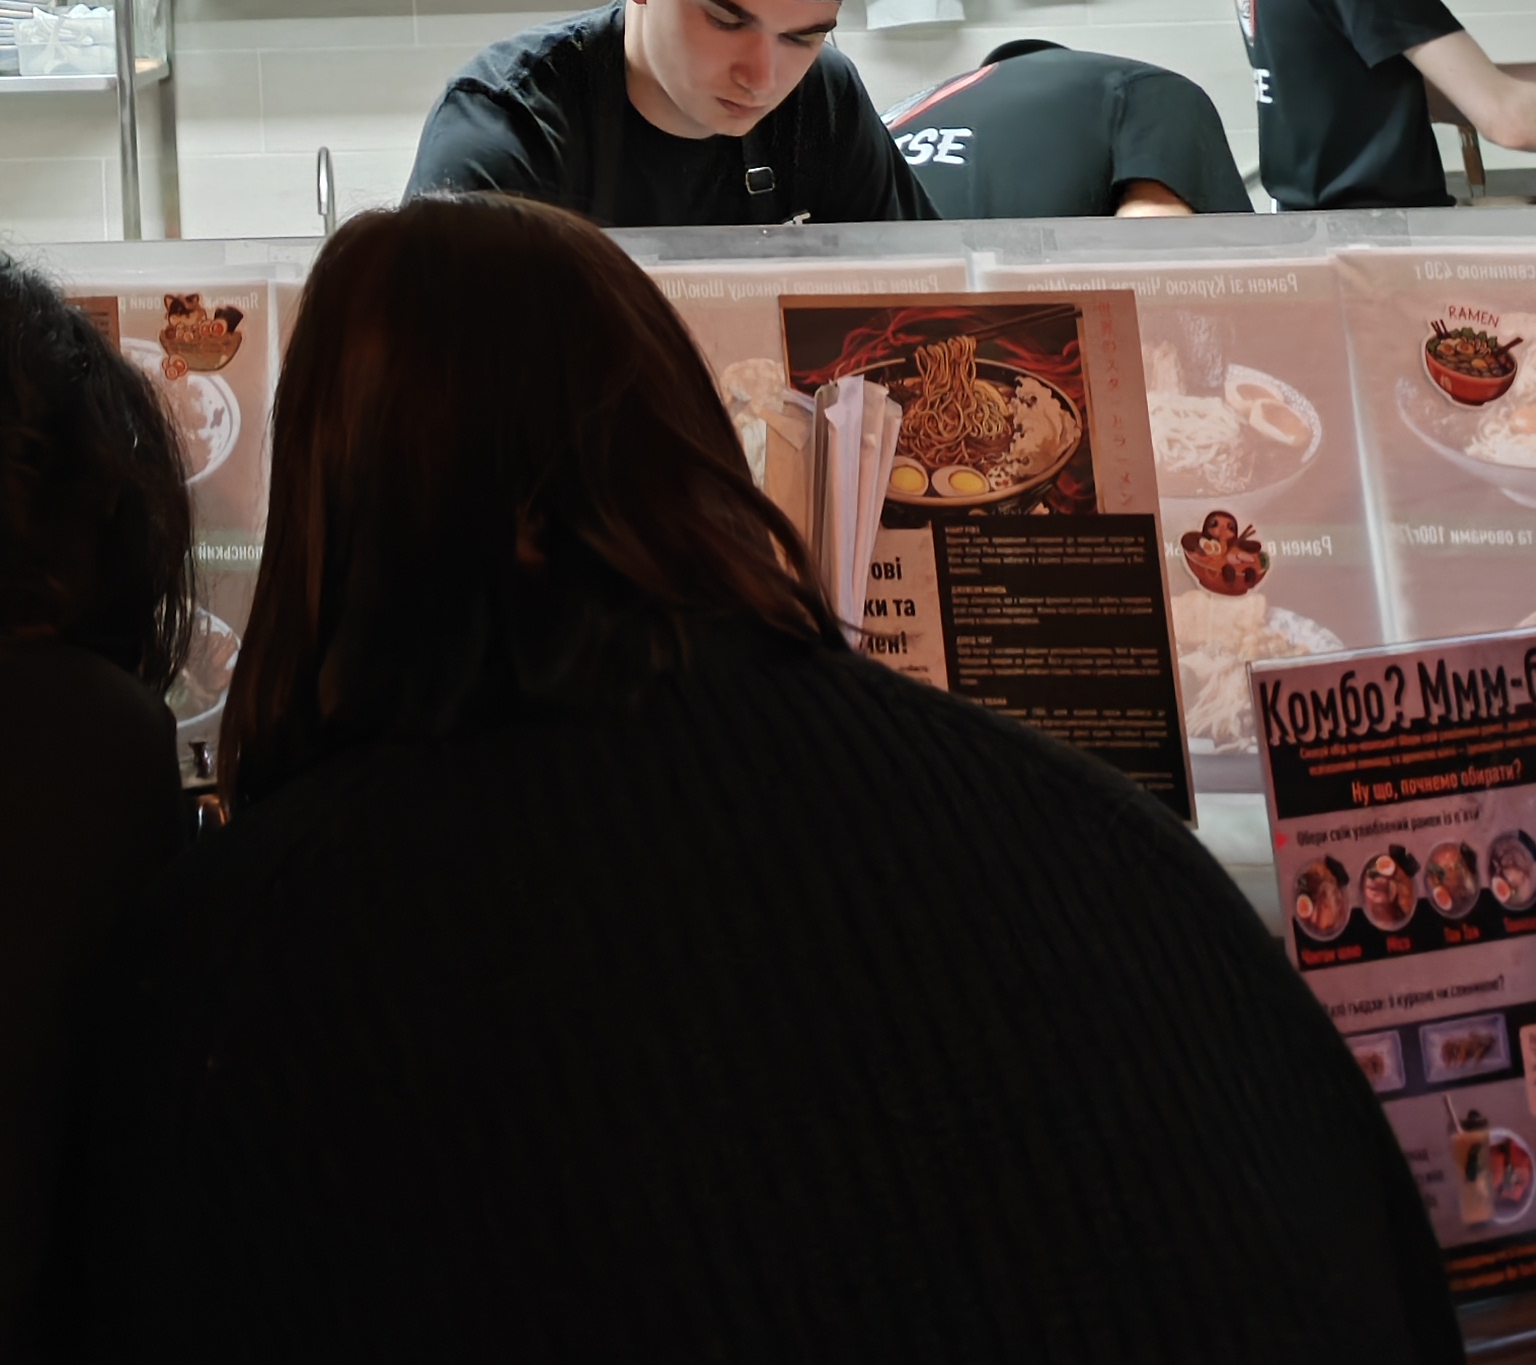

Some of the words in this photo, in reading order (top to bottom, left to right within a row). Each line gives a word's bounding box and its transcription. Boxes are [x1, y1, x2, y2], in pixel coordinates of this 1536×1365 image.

[1448, 305, 1500, 328] RAMEN
[870, 557, 902, 580] ові
[863, 599, 887, 616] ки
[892, 599, 916, 616] та
[1260, 664, 1406, 742] Комбо?
[1352, 780, 1370, 806] Ну
[1373, 780, 1398, 801] що,
[1401, 774, 1458, 797] почнемо
[1460, 758, 1522, 788] обирати?
